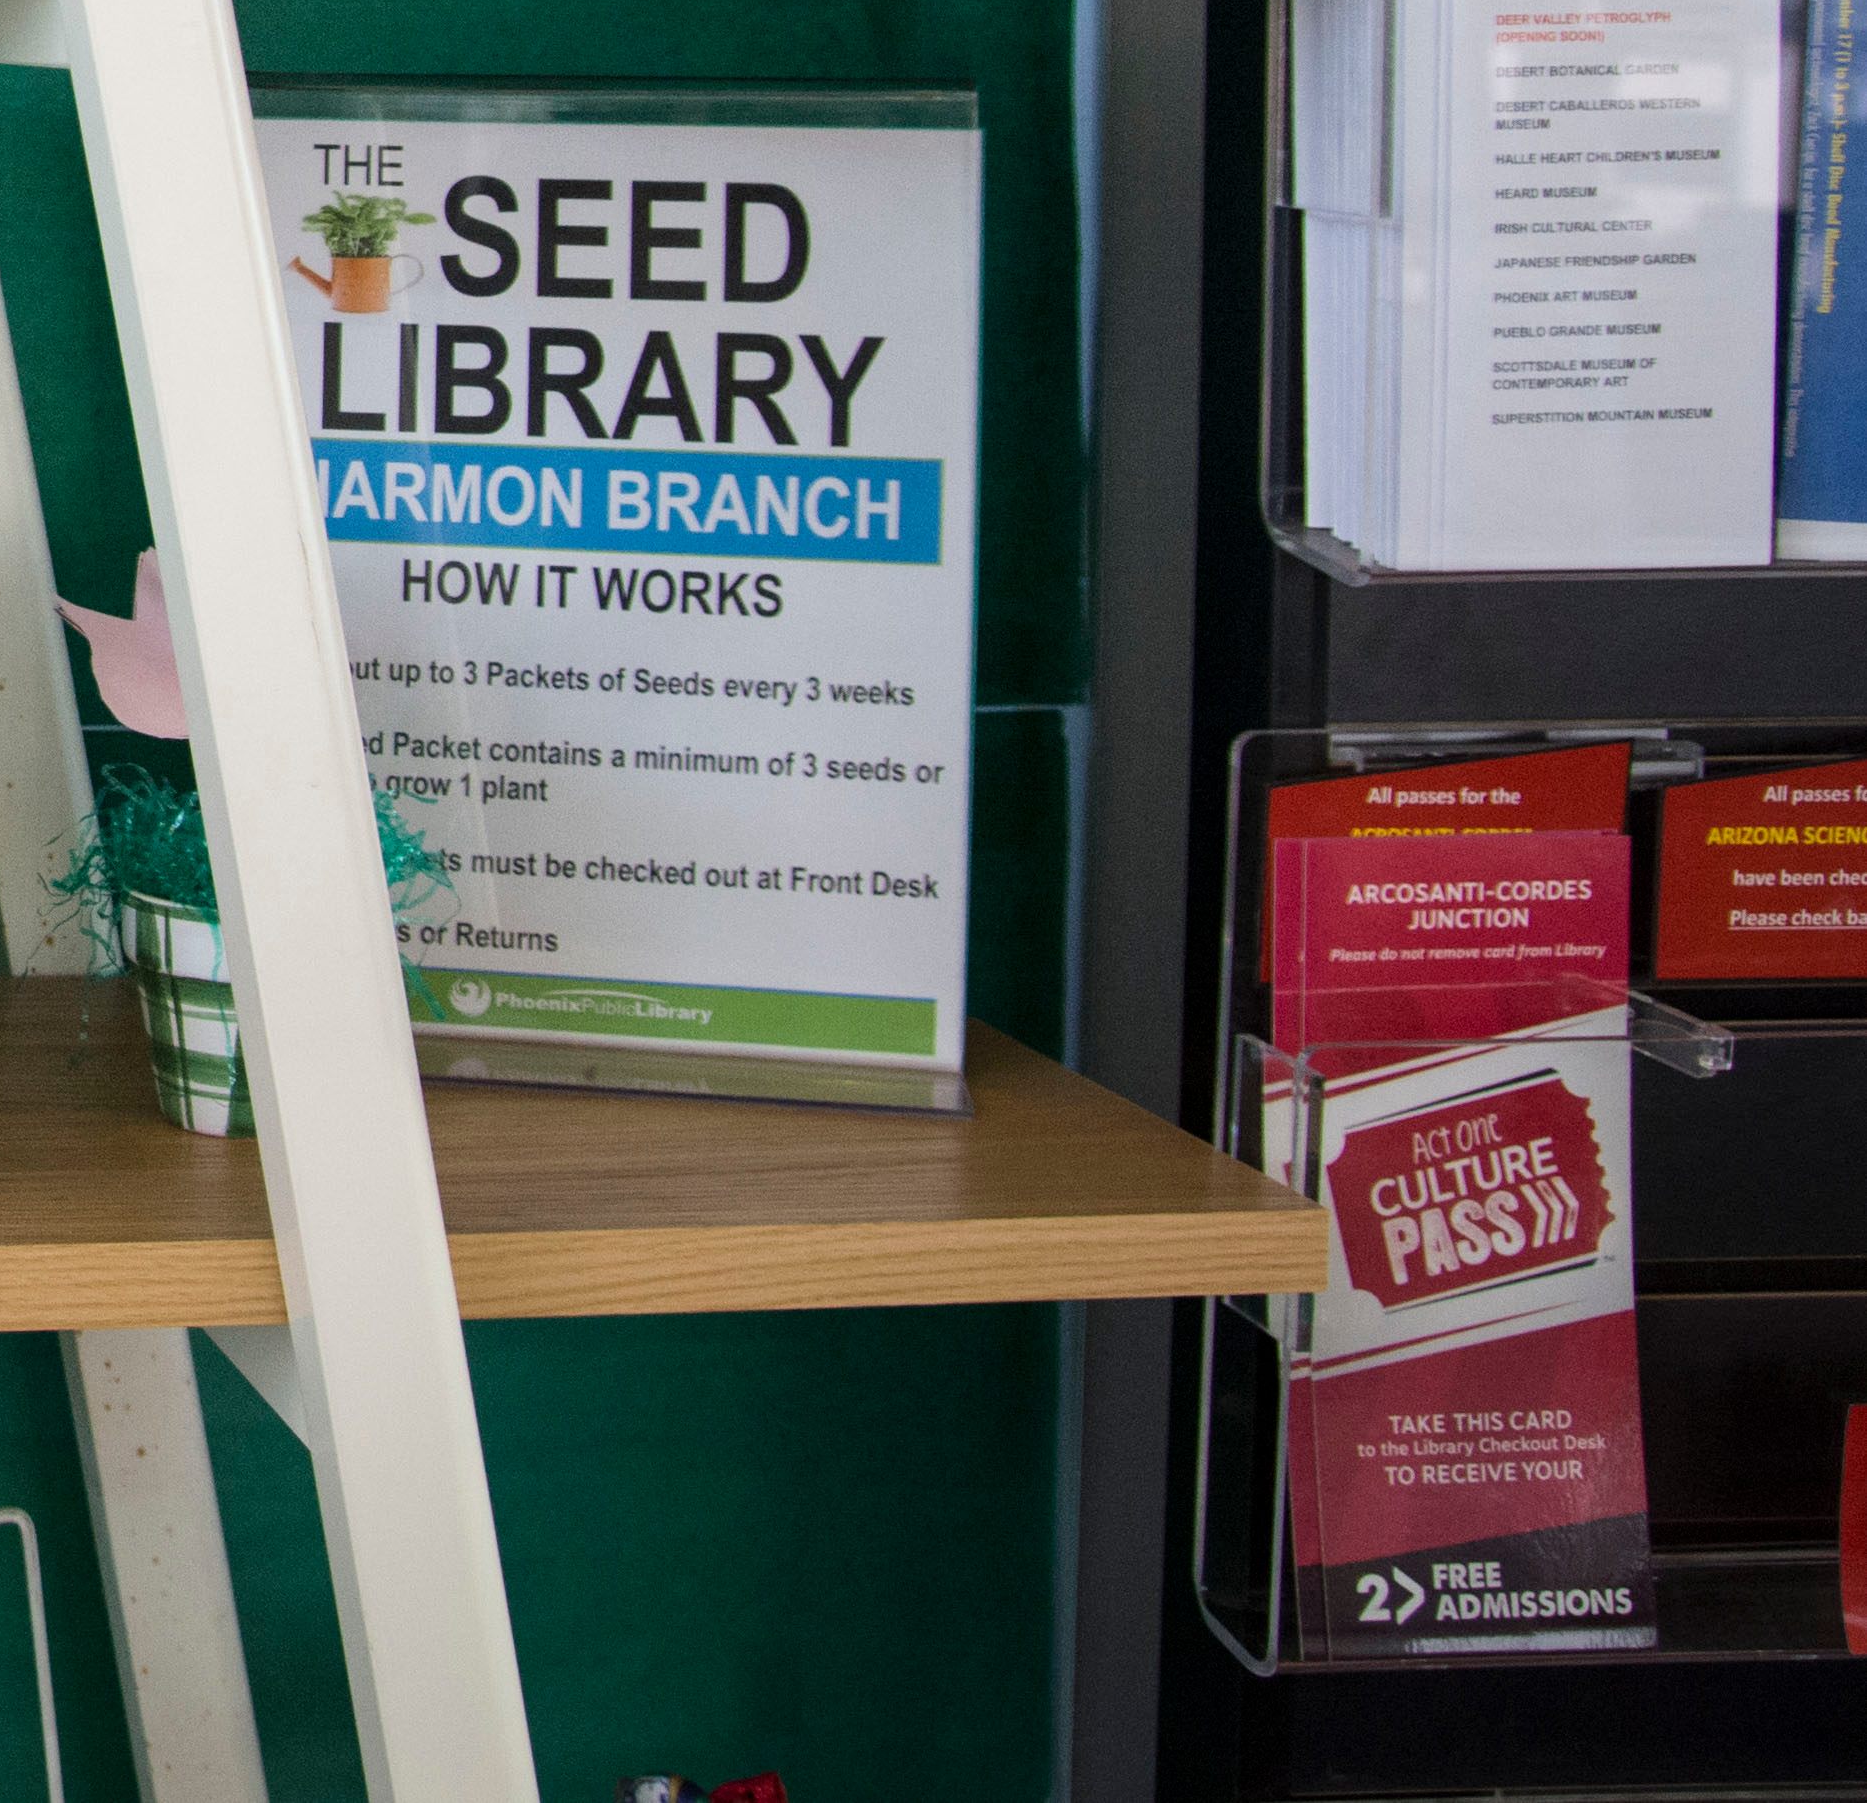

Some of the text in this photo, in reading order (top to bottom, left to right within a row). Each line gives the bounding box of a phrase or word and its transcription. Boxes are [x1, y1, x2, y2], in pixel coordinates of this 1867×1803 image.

[314, 144, 404, 186] THE
[1495, 186, 1597, 200] HEARD MUSEUM
[439, 176, 811, 303] SEED
[321, 321, 886, 447] LIBRARY
[607, 469, 901, 541] BRANCH
[402, 558, 783, 617] HOW IT WORKS
[390, 663, 421, 687] up
[430, 660, 454, 684] to
[464, 661, 478, 685] 3
[487, 662, 589, 691] Packets
[599, 668, 625, 693] of
[634, 668, 714, 697] Seeds
[724, 678, 797, 707] every
[807, 677, 821, 701] 3
[829, 680, 915, 707] weeks
[393, 732, 481, 760] Packet
[489, 738, 601, 767] contains
[611, 750, 625, 768] a
[635, 746, 758, 775] minimum
[768, 751, 795, 777] of
[803, 752, 817, 778] 3
[827, 756, 905, 782] seeds
[915, 764, 945, 784] or
[386, 773, 451, 799] grow
[460, 773, 472, 797] 1
[482, 776, 548, 804] plant
[1367, 787, 1521, 807] All passes for the
[1706, 827, 1798, 845] ARIZONA
[471, 852, 536, 875] must
[546, 853, 576, 878] be
[585, 856, 695, 886] checked
[705, 865, 749, 889] out
[757, 867, 782, 891] at
[791, 866, 863, 894] Front
[872, 871, 939, 899] Desk
[1347, 880, 1592, 904] ARCOSANTI-CORDES
[1408, 908, 1529, 930] JUNCTION
[420, 924, 448, 944] or
[456, 923, 558, 952] Returns
[1371, 1137, 1558, 1216] CULTURE
[1382, 1190, 1525, 1285] PASS
[1389, 1410, 1572, 1434] TAKE THIS CARD
[1357, 1434, 1606, 1459] to the Library Checkout Desk
[1385, 1461, 1583, 1485] TO RECEIVE YOUR
[1433, 1562, 1502, 1590] FREE
[1356, 1573, 1391, 1622] 2
[1436, 1588, 1633, 1621] ADMISSIONS
